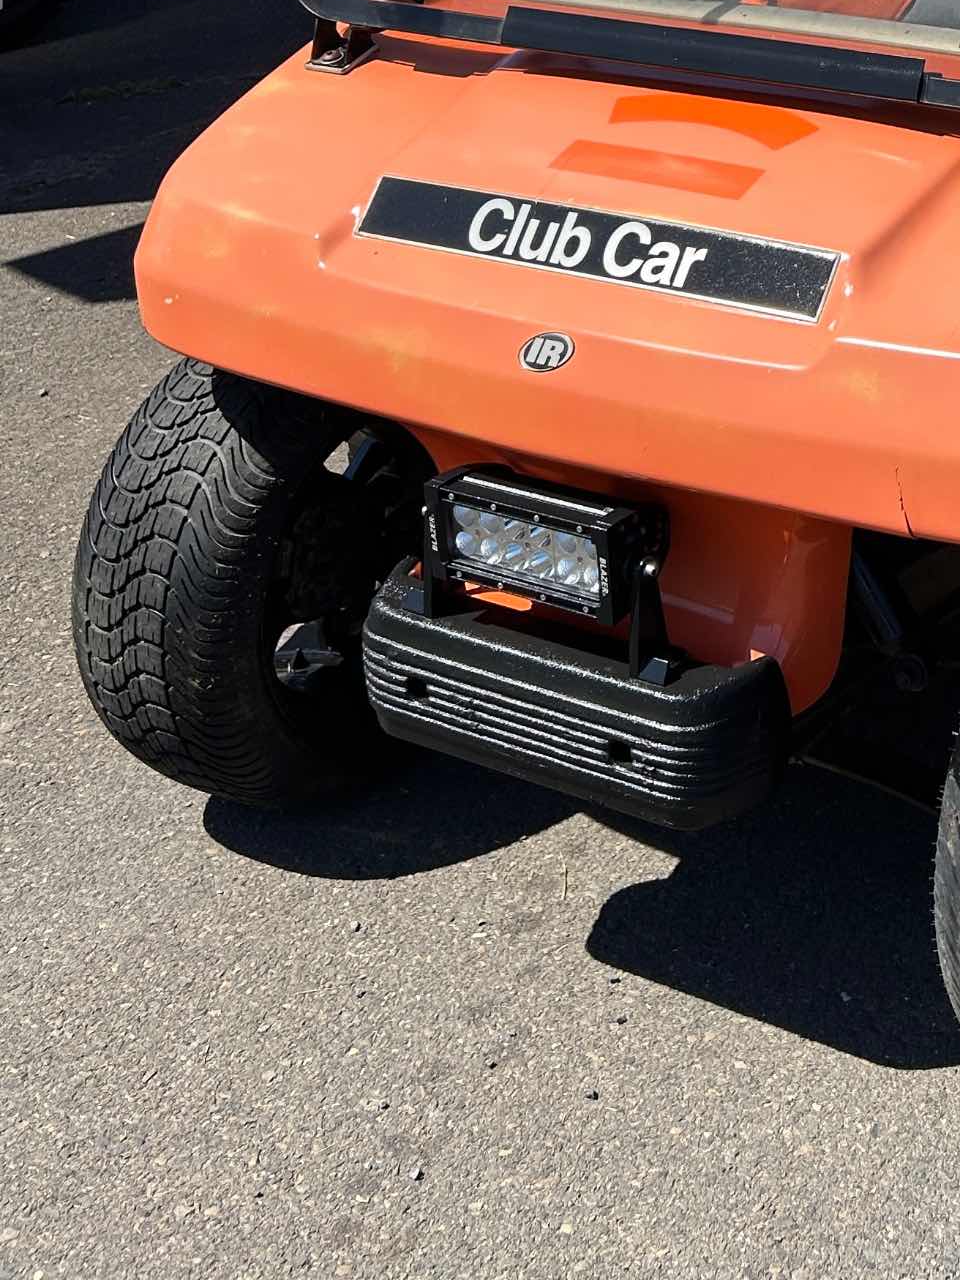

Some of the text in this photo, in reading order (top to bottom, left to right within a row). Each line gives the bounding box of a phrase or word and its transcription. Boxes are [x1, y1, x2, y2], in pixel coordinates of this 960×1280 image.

[468, 198, 708, 288] Club Car
[525, 337, 565, 368] IR
[599, 557, 609, 597] BLAZER
